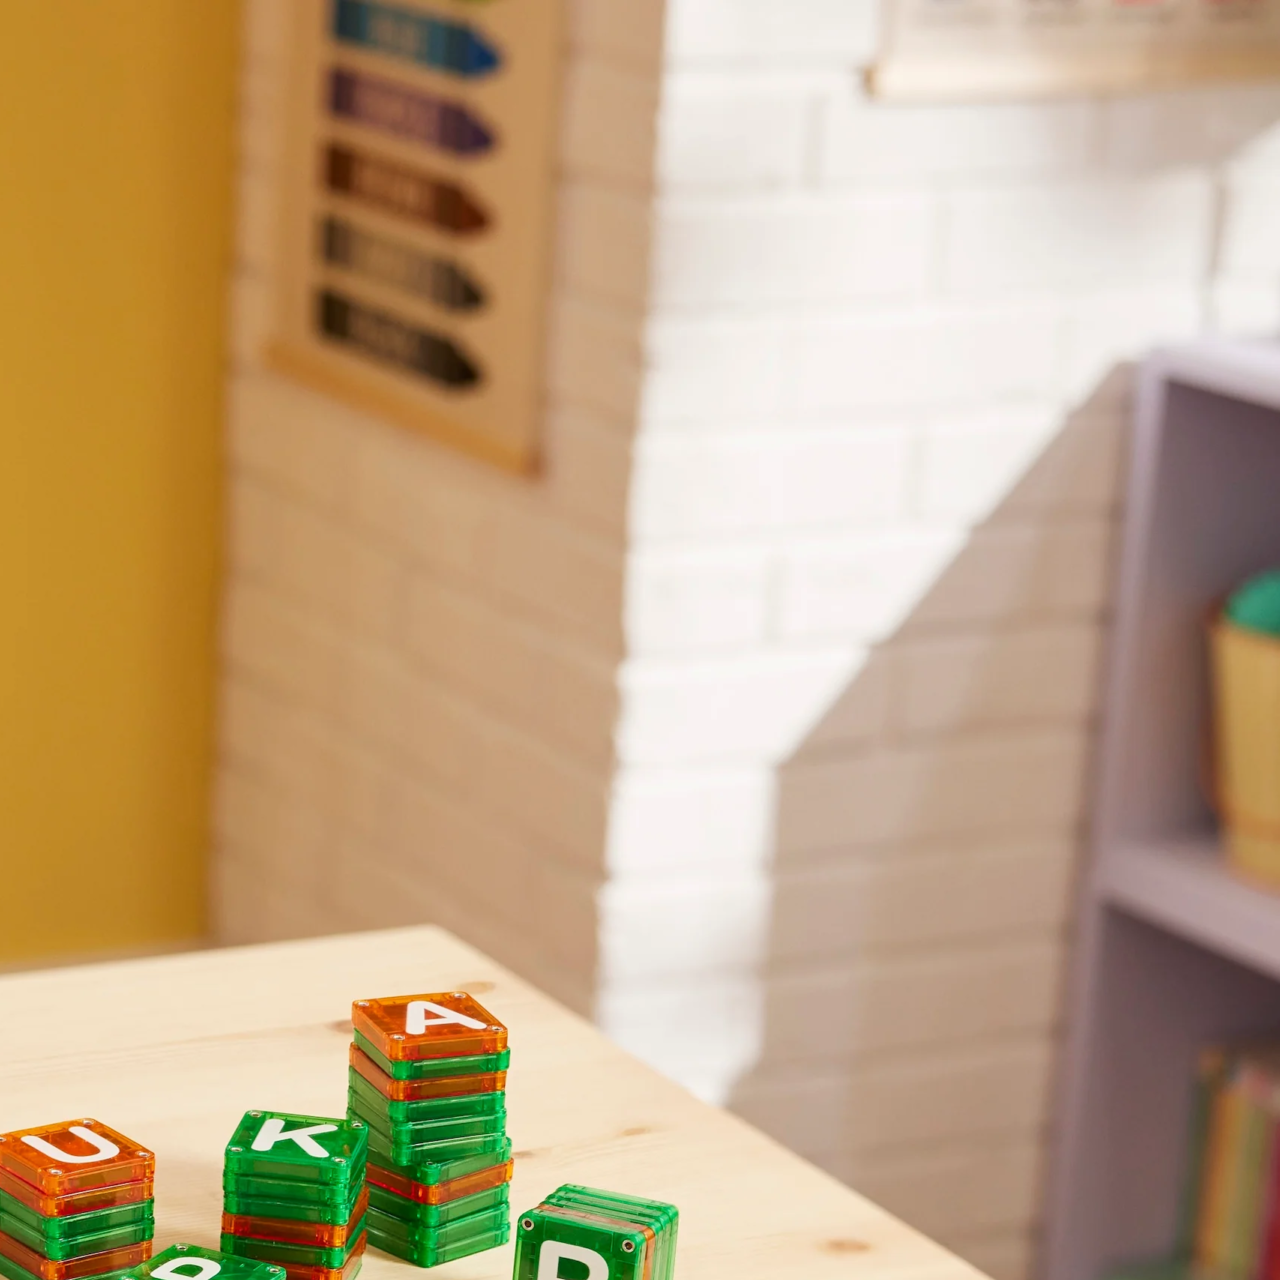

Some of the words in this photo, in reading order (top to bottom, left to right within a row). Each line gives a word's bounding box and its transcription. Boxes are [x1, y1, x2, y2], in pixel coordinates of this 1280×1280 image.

[405, 1000, 487, 1035] A
[22, 1126, 120, 1164] U
[252, 1119, 339, 1158] K
